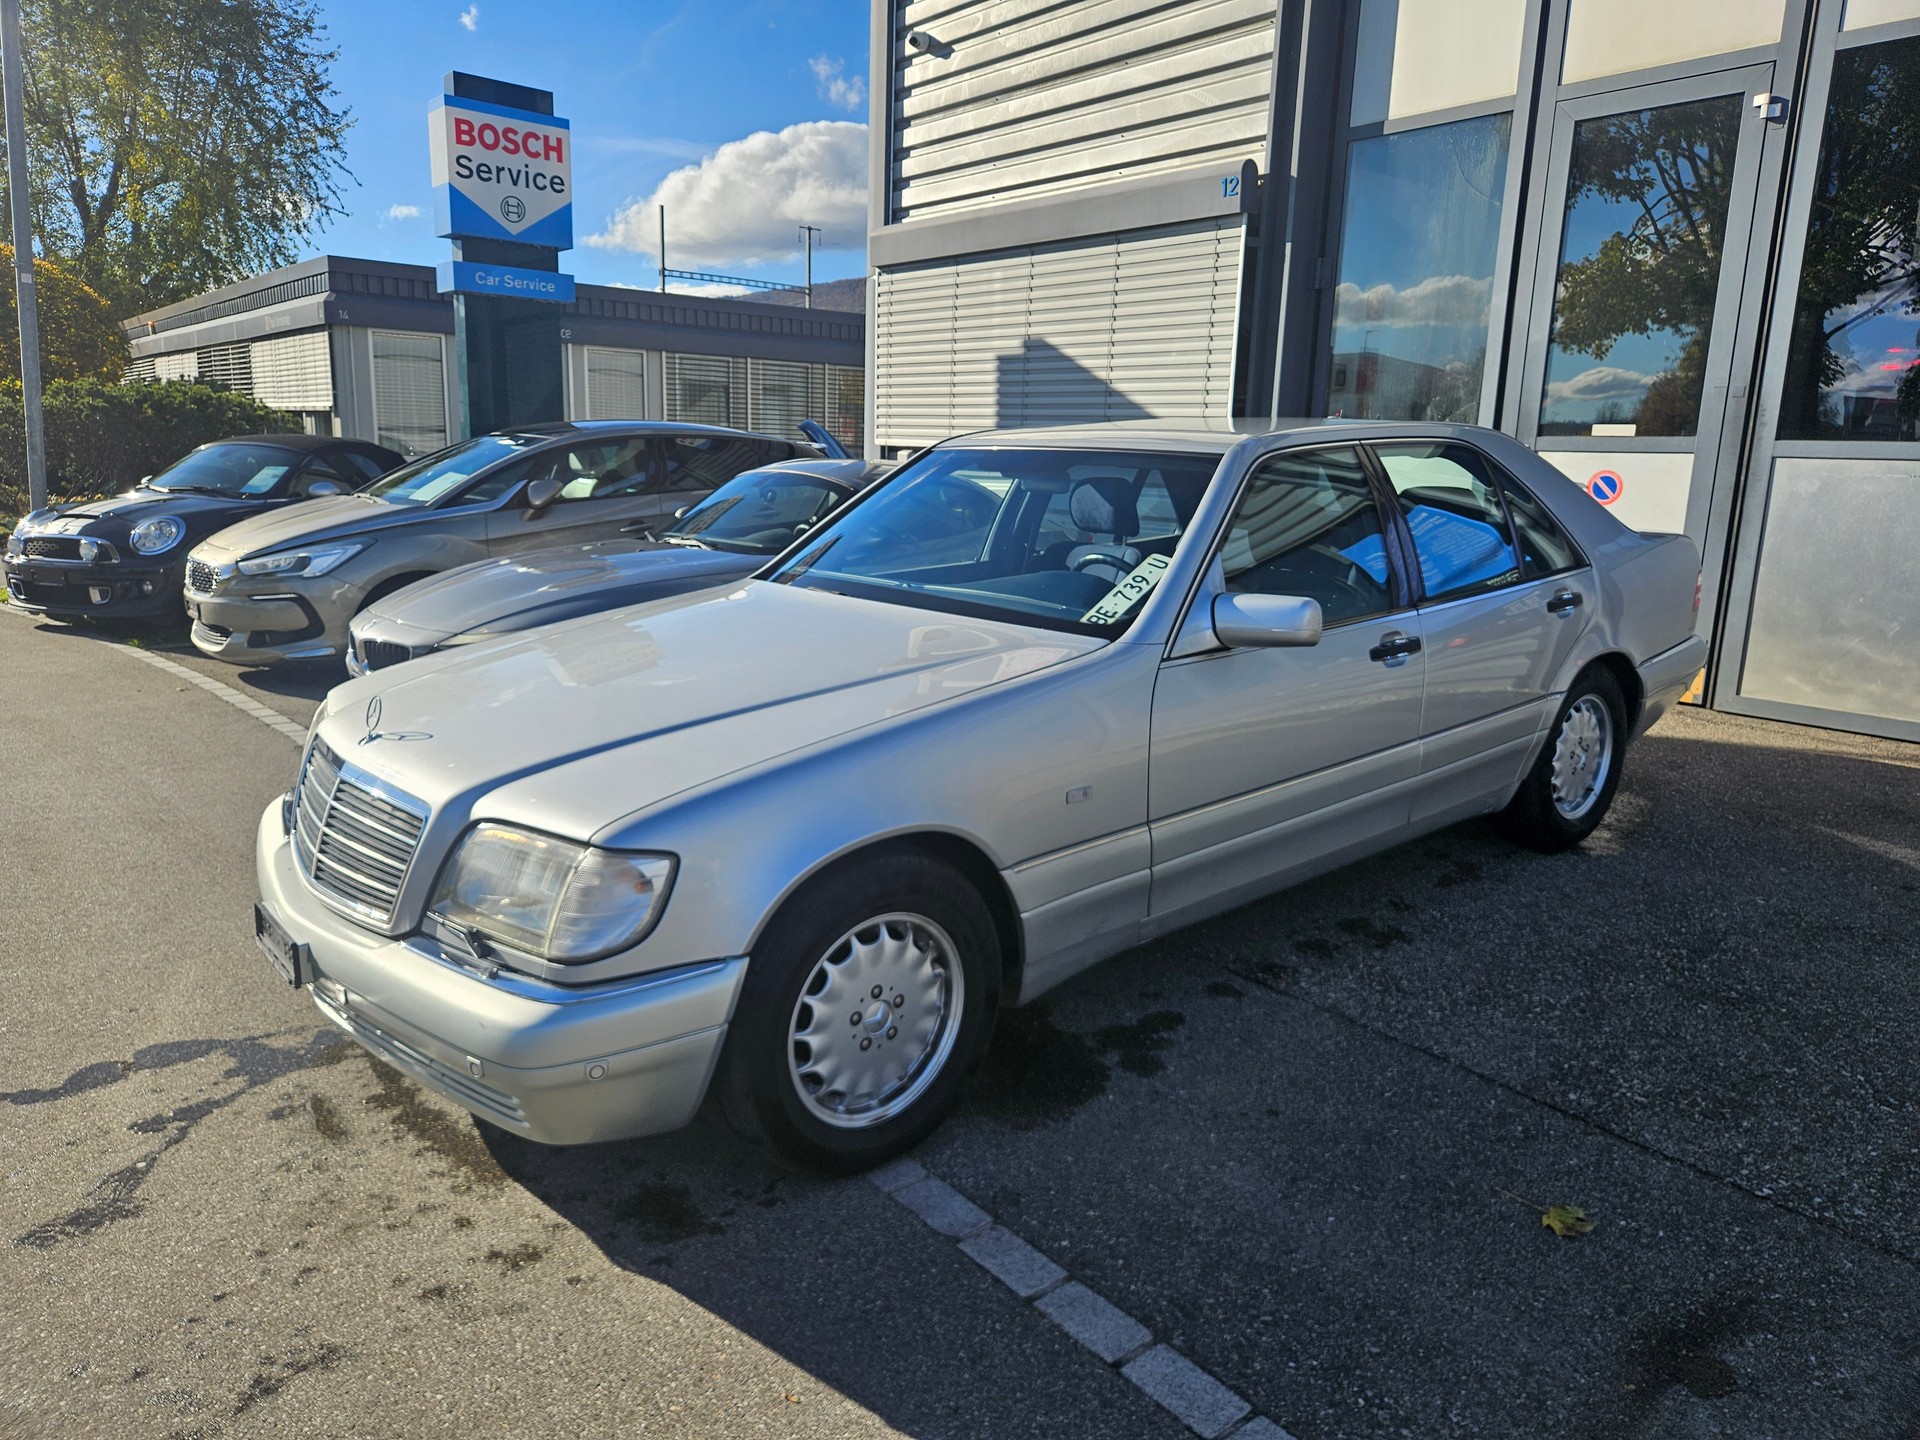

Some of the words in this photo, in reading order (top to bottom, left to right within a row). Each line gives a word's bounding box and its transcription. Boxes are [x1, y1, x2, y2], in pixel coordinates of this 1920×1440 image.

[454, 116, 564, 164] BOSCH
[455, 154, 565, 194] Service
[1221, 175, 1240, 198] 12
[475, 271, 500, 286] Car
[504, 274, 556, 293] Service
[338, 309, 349, 320] 14
